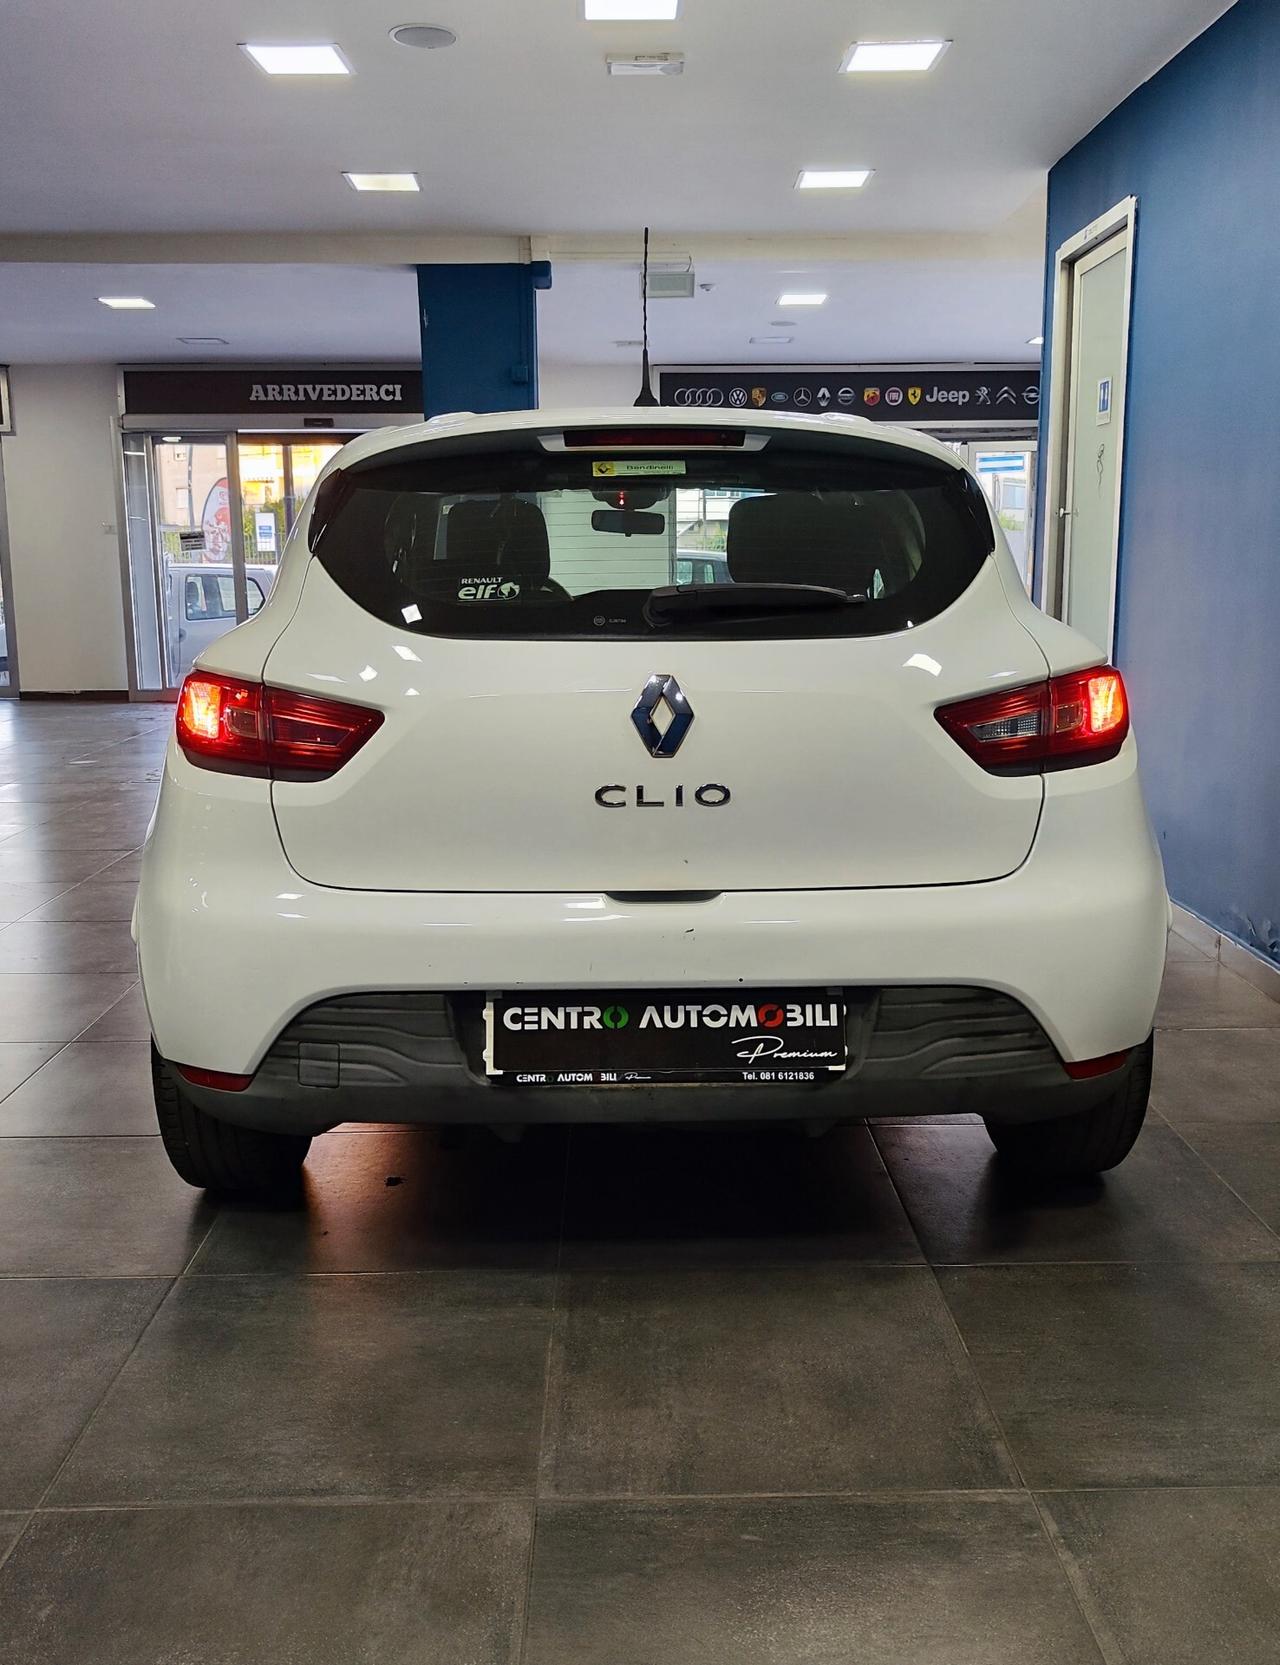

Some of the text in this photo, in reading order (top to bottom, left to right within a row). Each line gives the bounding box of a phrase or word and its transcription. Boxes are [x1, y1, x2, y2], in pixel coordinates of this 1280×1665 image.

[250, 384, 402, 401] ARRIVEDERCI
[925, 386, 970, 406] Jeep
[461, 577, 503, 585] RENAULT
[458, 584, 498, 599] elf
[594, 783, 731, 808] CLIO
[503, 1003, 838, 1031] CENTRO AUTOMOBILI
[731, 1035, 838, 1064] Premium
[557, 1073, 617, 1082] AUTOMBILI
[742, 1071, 814, 1080] Tel. 081 6121836
